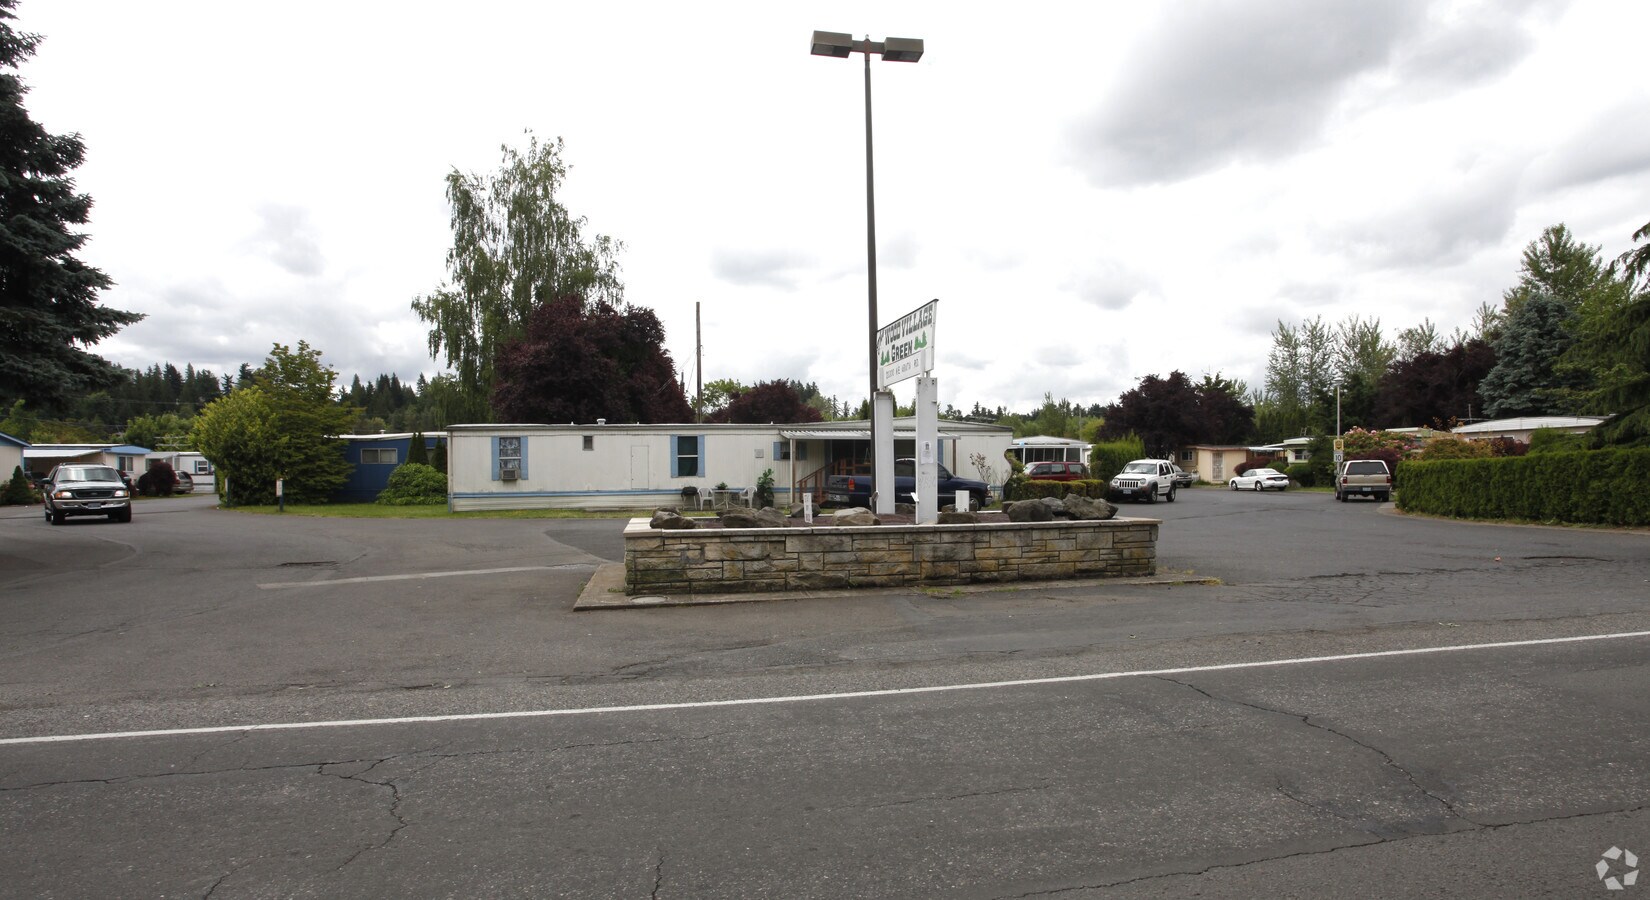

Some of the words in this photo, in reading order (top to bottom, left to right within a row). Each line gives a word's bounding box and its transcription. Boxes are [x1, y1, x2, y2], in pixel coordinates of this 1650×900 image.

[885, 321, 901, 346] WOOD
[902, 303, 934, 338] VILLAGE
[891, 339, 913, 362] GREEN
